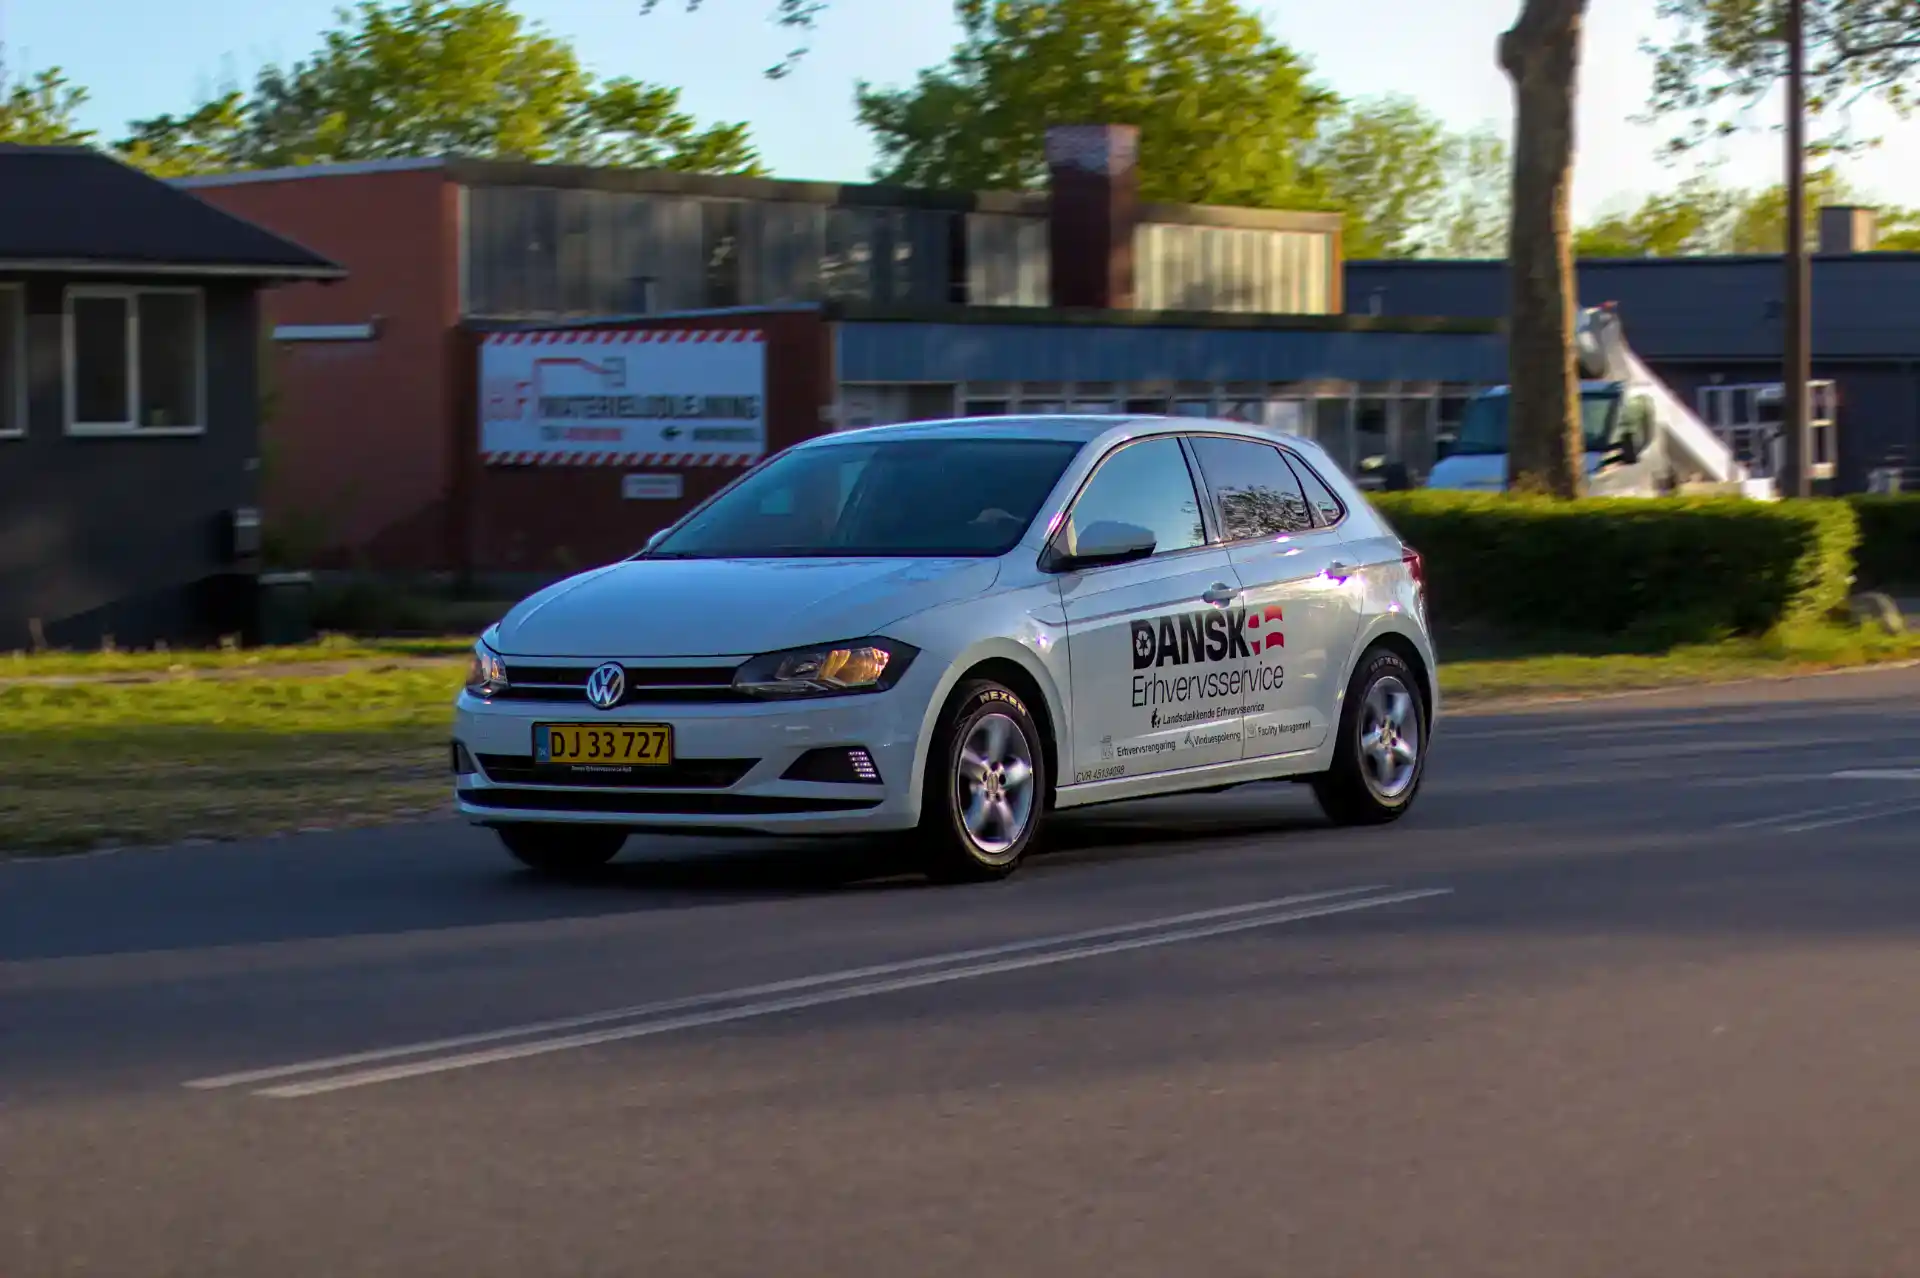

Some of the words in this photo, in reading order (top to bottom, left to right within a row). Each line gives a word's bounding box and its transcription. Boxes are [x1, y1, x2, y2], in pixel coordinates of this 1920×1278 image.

[1131, 610, 1250, 669] DANSK
[1131, 661, 1285, 707] Erhvervsservice
[980, 691, 1026, 716] NEXEN
[551, 731, 582, 759] DJ
[588, 731, 616, 759] 33
[622, 731, 666, 759] 727
[1075, 769, 1093, 783] CVR
